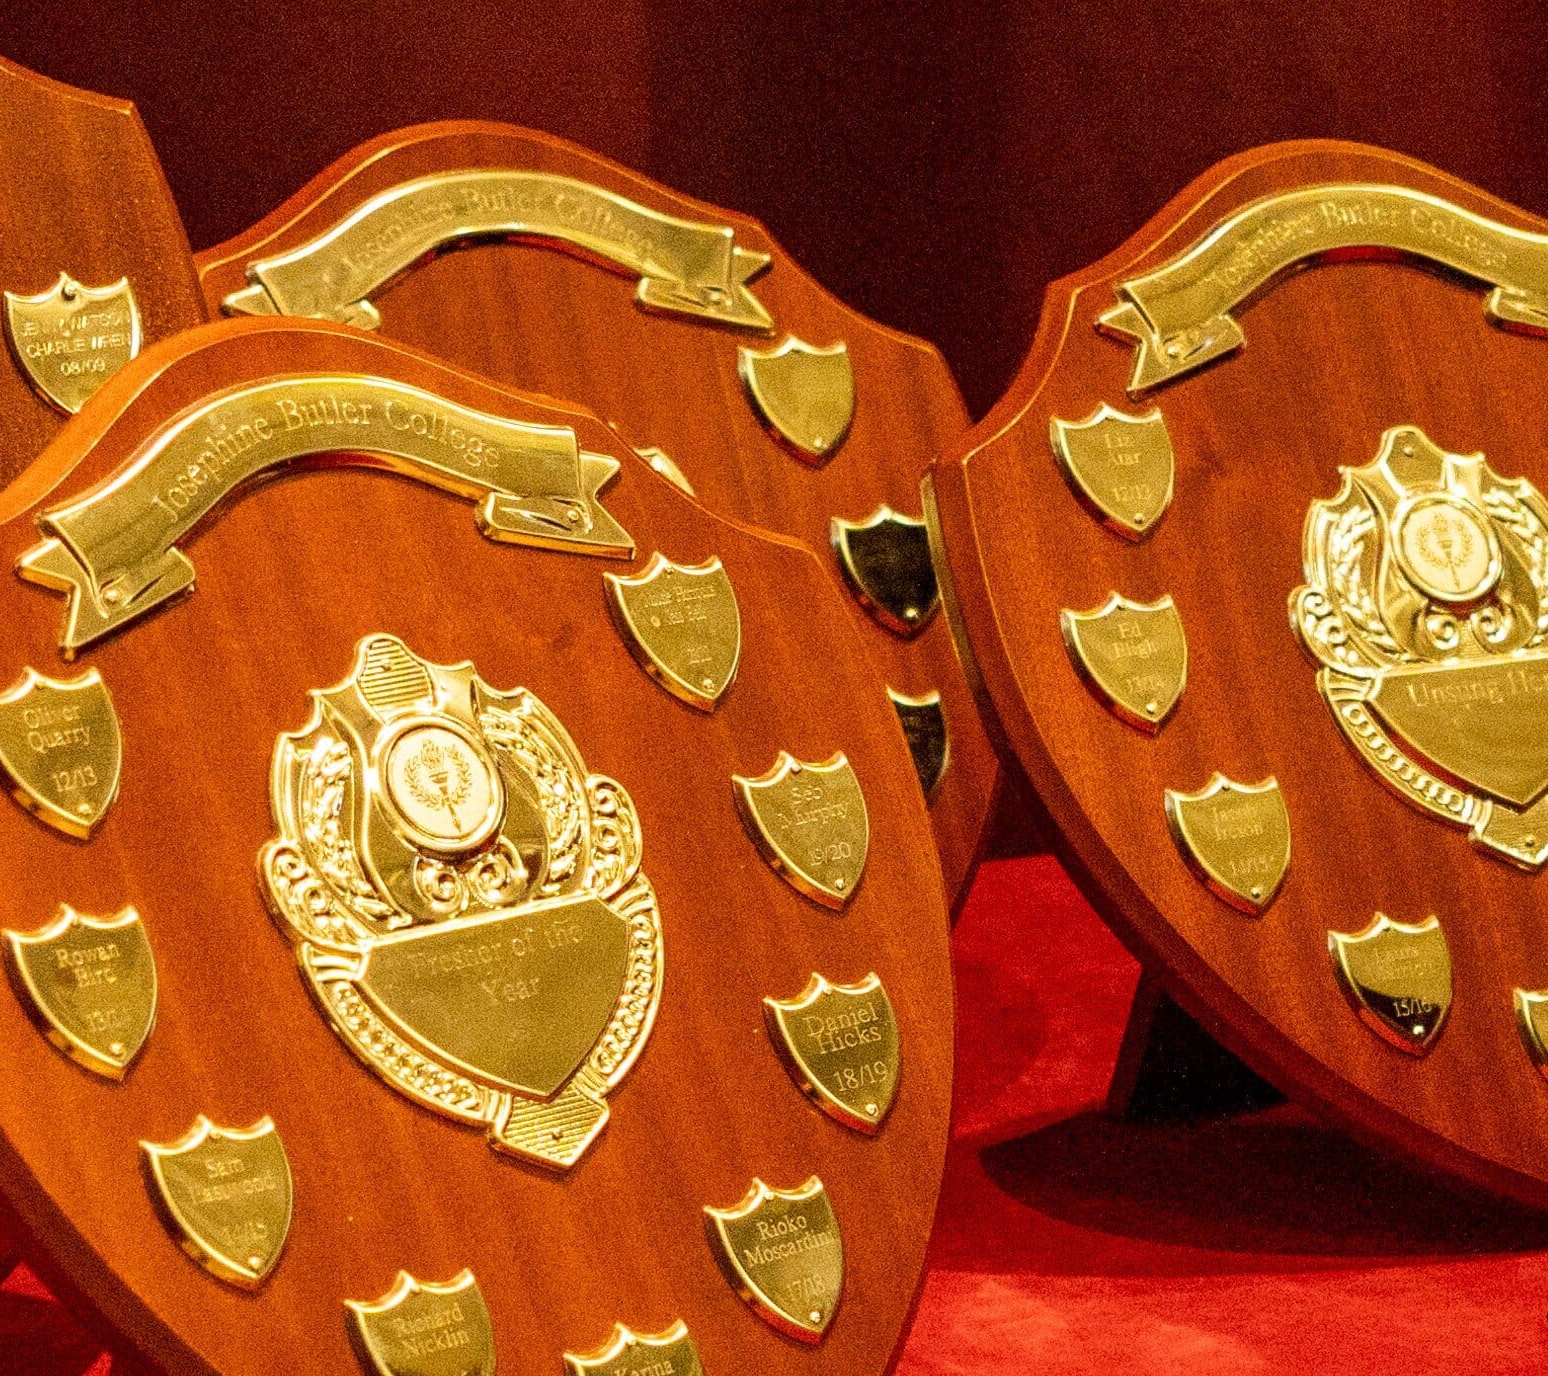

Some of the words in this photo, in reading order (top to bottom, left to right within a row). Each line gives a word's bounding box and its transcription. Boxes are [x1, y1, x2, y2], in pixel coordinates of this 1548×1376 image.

[460, 186, 551, 215] Butler
[1211, 214, 1317, 291] Josephine
[1318, 200, 1402, 231] Butler
[1409, 205, 1510, 269] College
[151, 412, 274, 523] Josephine
[282, 396, 374, 428] Butler
[383, 398, 502, 470] College
[1118, 620, 1143, 639] Ed
[1406, 679, 1505, 709] Unsung
[21, 704, 82, 730] Oliver
[26, 725, 92, 755] Quarry
[50, 764, 99, 794] 12/13
[510, 924, 535, 954] of
[54, 942, 122, 970] Rowan
[479, 973, 542, 1005] Year
[801, 1001, 880, 1039] Daniel
[813, 1024, 883, 1057] Hicks
[832, 1060, 890, 1093] 18/19
[755, 1214, 809, 1242] Rioko
[742, 1226, 836, 1270] Moscardini
[400, 1327, 471, 1361] Nicklin
